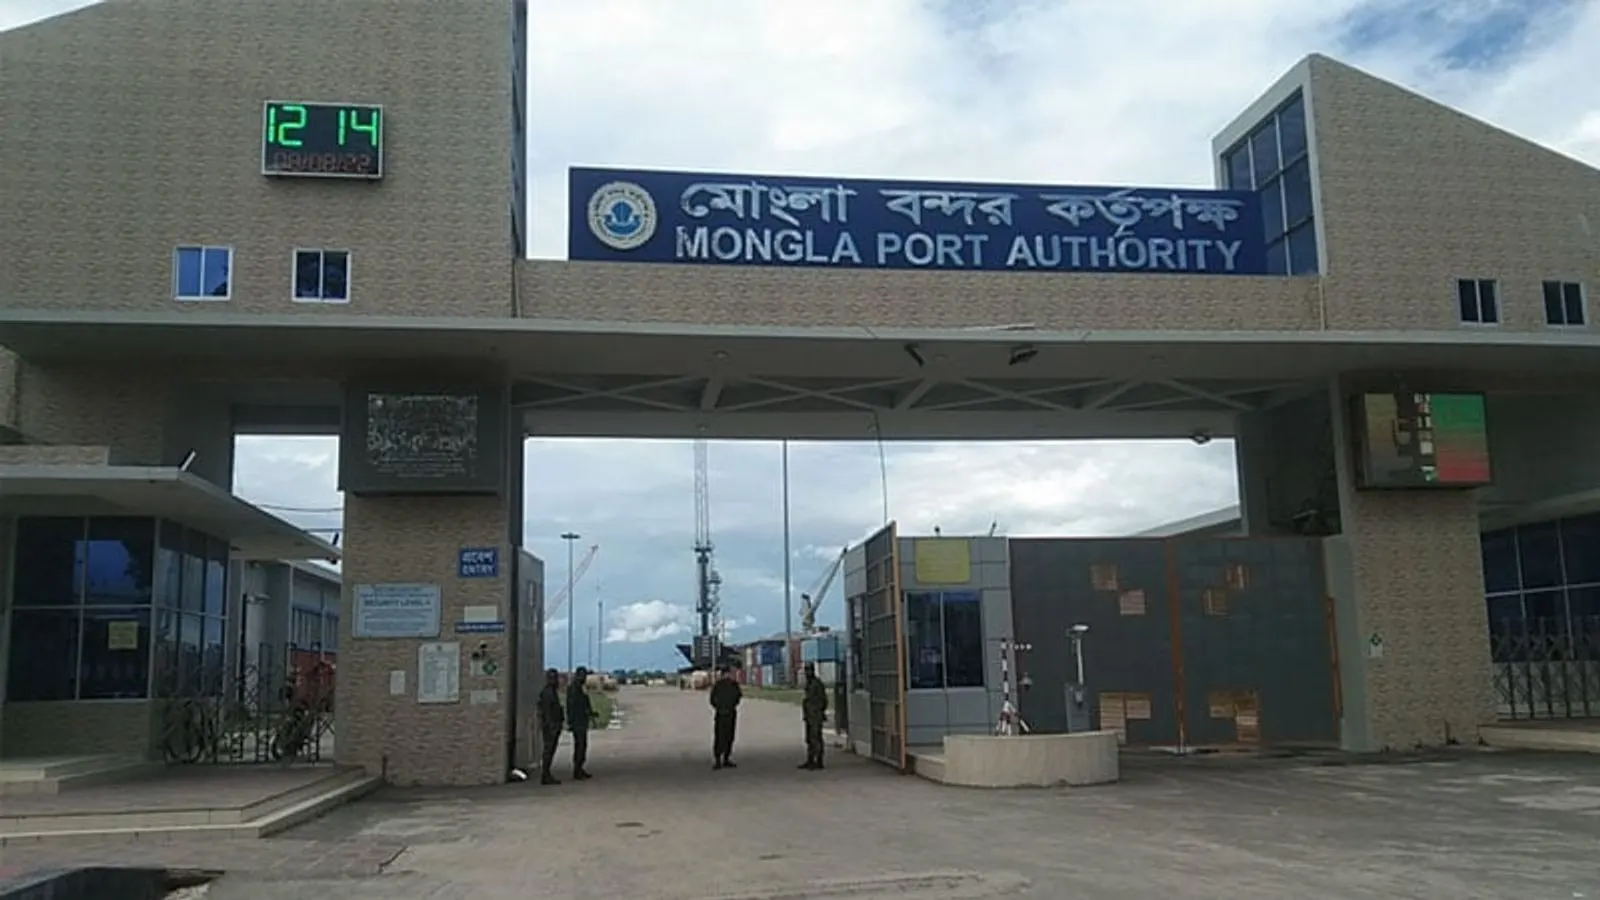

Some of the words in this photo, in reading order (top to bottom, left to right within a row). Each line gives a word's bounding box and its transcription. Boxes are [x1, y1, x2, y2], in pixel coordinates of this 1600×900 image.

[268, 105, 307, 146] 12
[338, 109, 378, 147] 14
[680, 180, 858, 227] মোংলা
[878, 189, 1019, 226] বন্দর
[1040, 188, 1244, 237] কর্তৃপক্ষ
[675, 225, 862, 264] MONGLA
[877, 231, 989, 266] PORT
[1006, 235, 1242, 271] AUTHORITY
[462, 563, 494, 576] ENTRY
